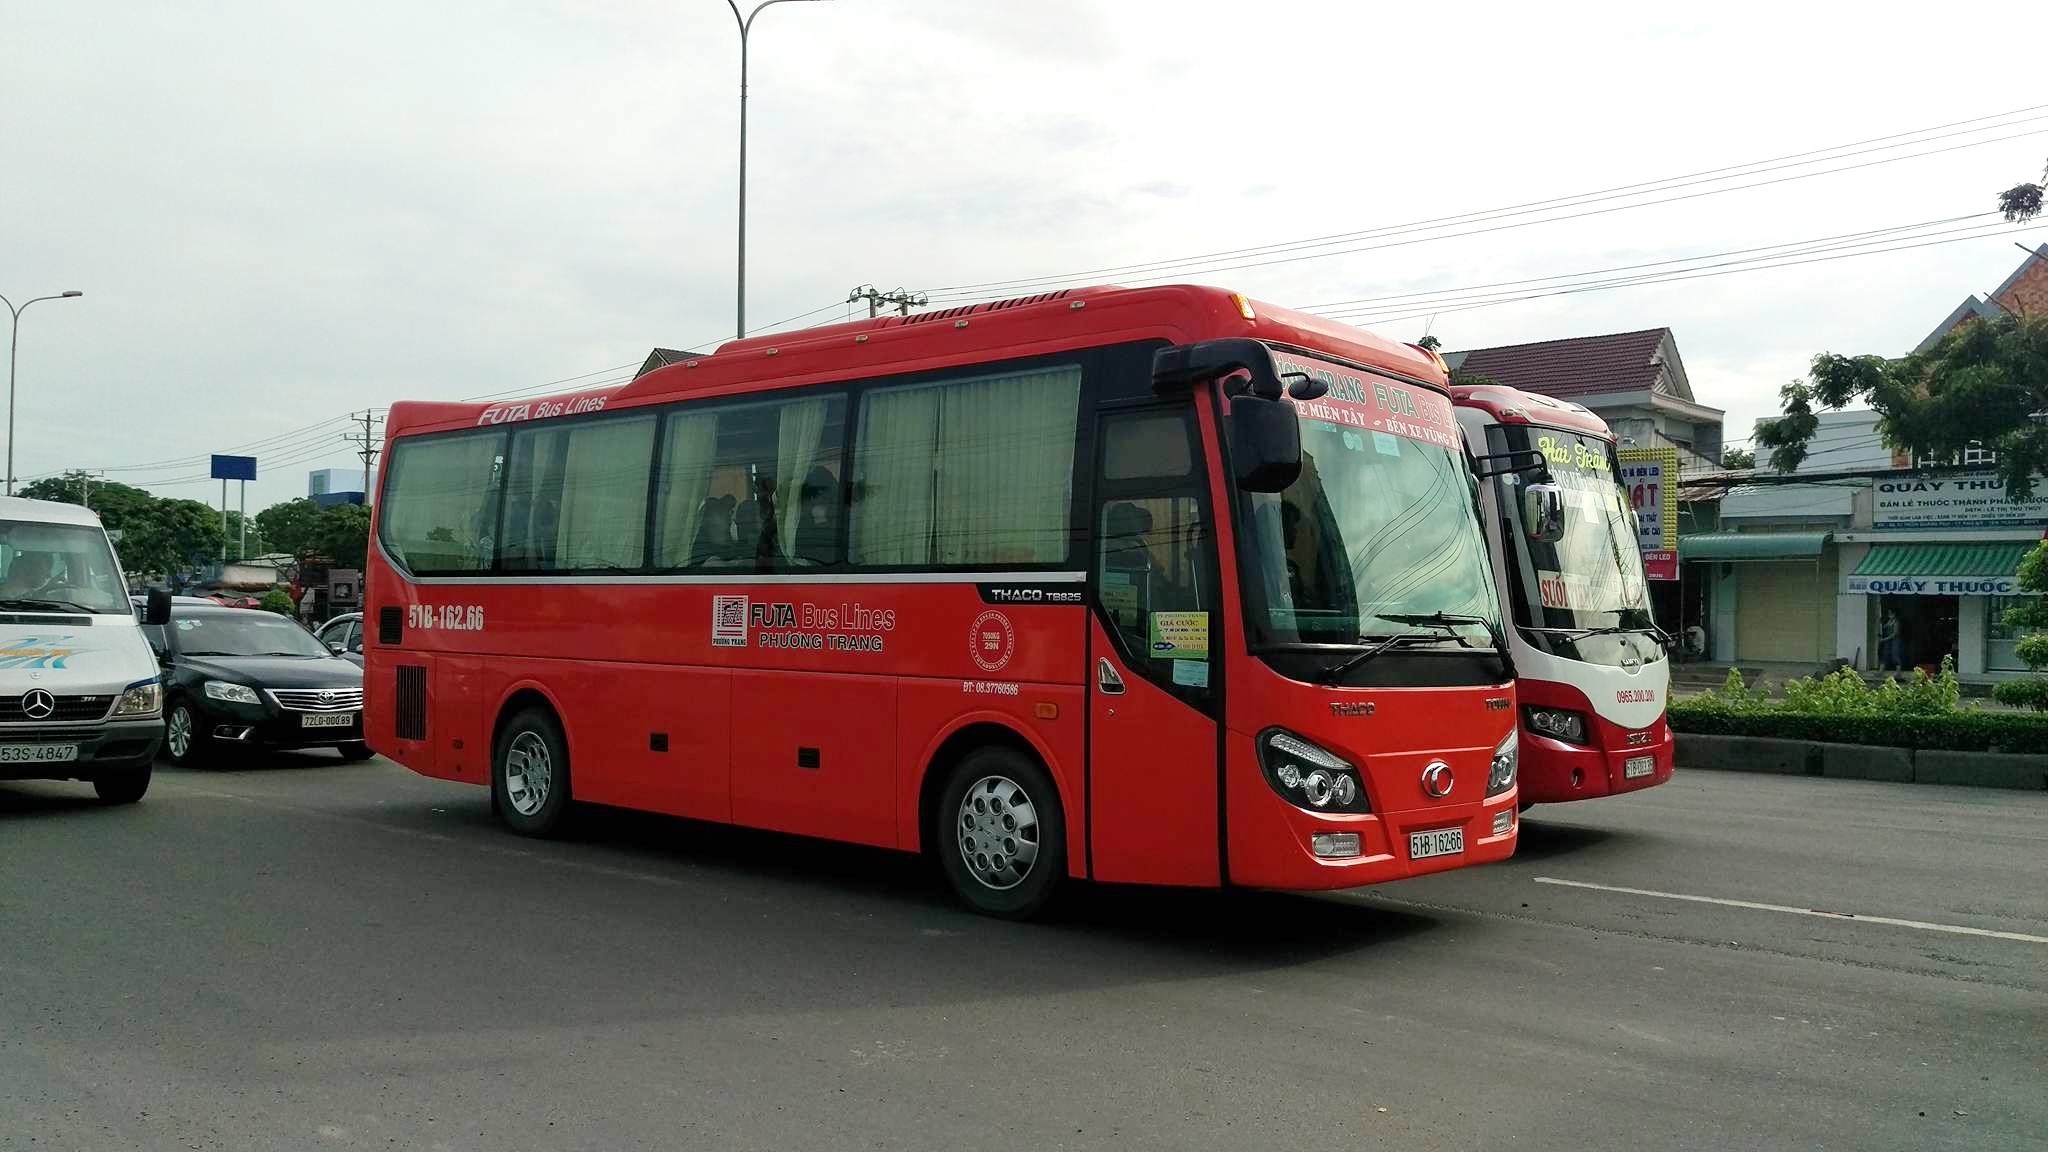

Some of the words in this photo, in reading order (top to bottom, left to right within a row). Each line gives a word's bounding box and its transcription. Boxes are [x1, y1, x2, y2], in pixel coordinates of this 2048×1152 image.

[477, 403, 530, 426] FUTA
[534, 401, 562, 418] Bus
[565, 396, 608, 415] Lines
[1372, 382, 1420, 419] FUTA
[1309, 399, 1340, 421] MIỀN
[1341, 407, 1365, 426] TÂY
[1385, 414, 1407, 435] BẾN
[1407, 423, 1423, 439] XE
[1423, 426, 1450, 445] VŨNG
[1538, 437, 1571, 463] Hai
[1953, 478, 2040, 491] THUC
[992, 589, 1042, 600] THACO
[408, 604, 484, 631] 51B-162.66
[751, 603, 797, 628] FUTA
[802, 602, 838, 630] Bus
[841, 603, 896, 631] Lines
[760, 631, 822, 649] PHƯƠNG
[827, 634, 883, 652] TRANG
[984, 641, 999, 650] 29N
[1330, 702, 1376, 716] THACO
